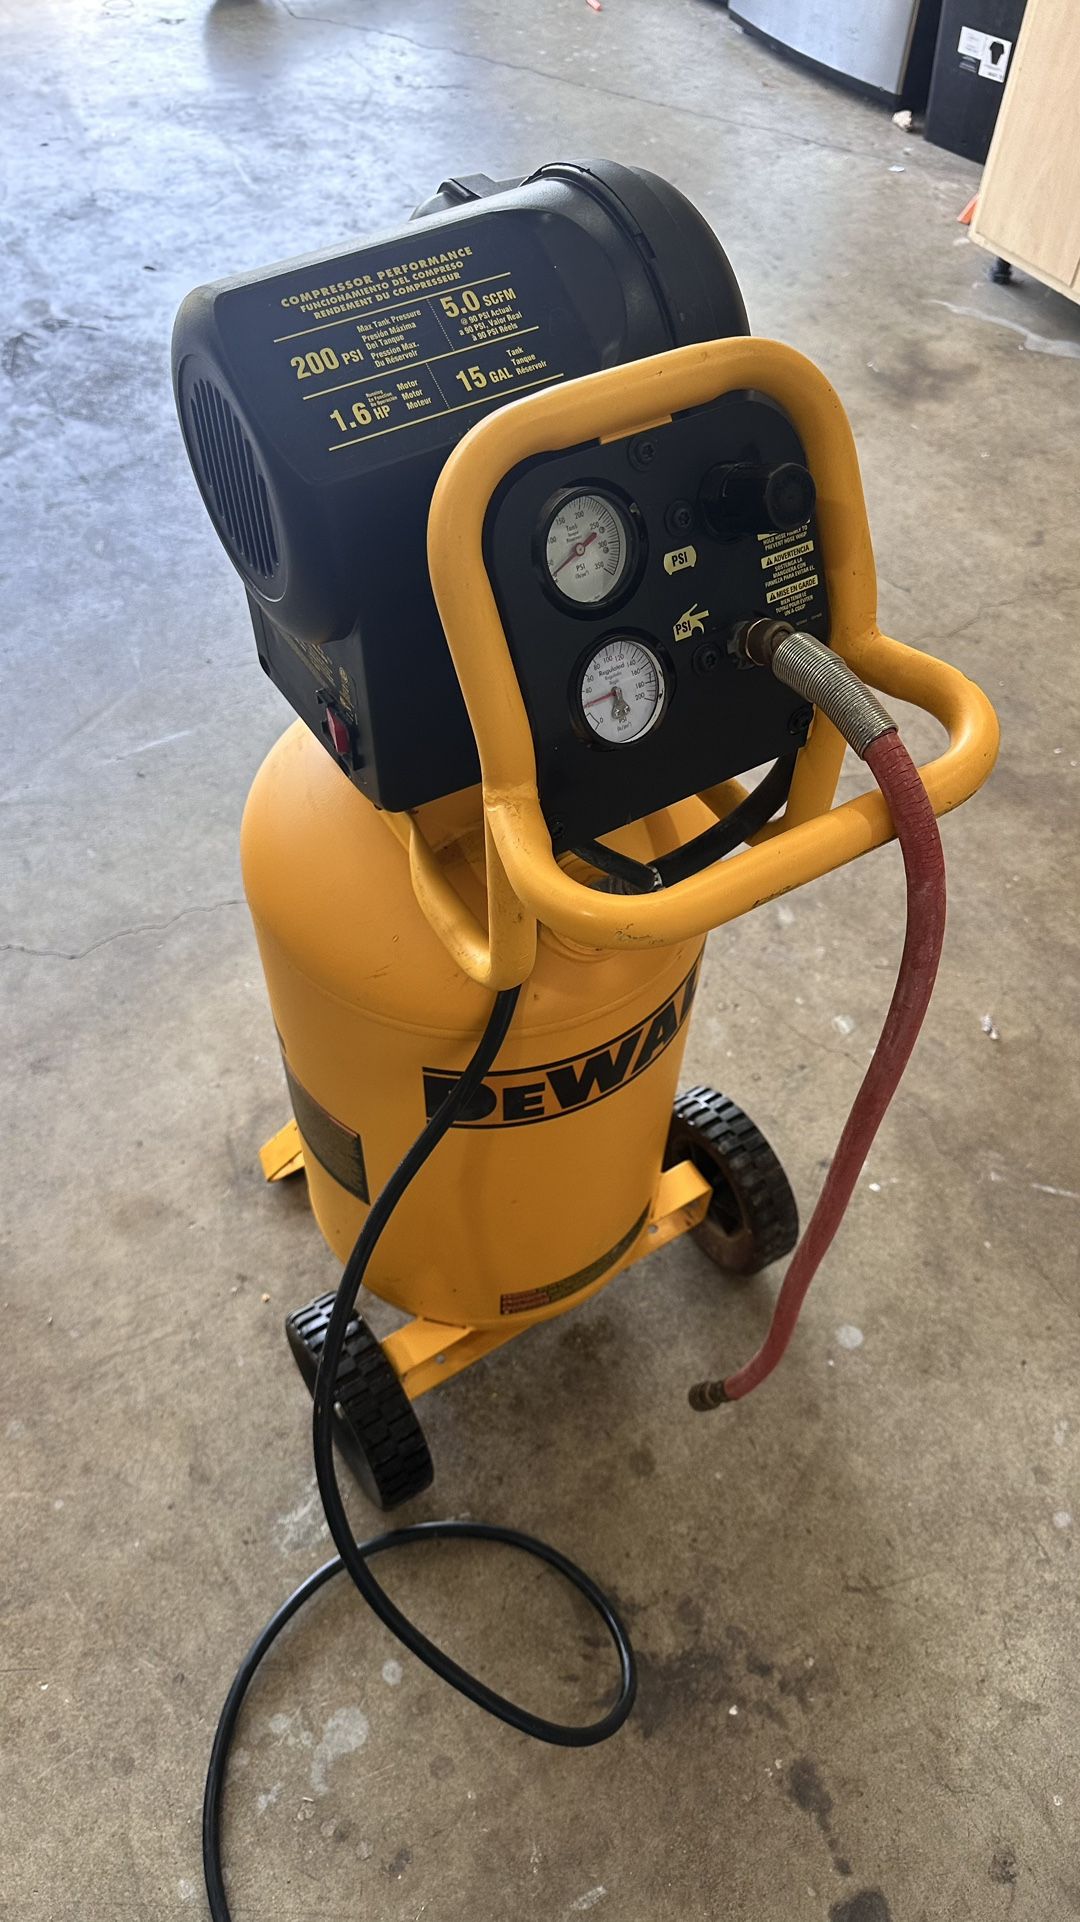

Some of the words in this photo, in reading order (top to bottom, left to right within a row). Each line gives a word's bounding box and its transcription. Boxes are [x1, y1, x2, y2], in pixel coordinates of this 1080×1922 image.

[280, 275, 373, 308] COMPRESSOR
[376, 246, 473, 281] PERFORMANCE
[300, 282, 390, 313] FUNCIONAMIENTO
[392, 275, 410, 287] DEL
[412, 260, 464, 281] COMPRESO
[314, 297, 373, 320] RENDEMENT
[375, 291, 390, 302] DU
[392, 271, 461, 296] COMPRESSEUR
[440, 290, 481, 318] 5.0
[482, 287, 517, 307] SCFM
[356, 324, 373, 334] Max
[373, 317, 391, 328] Tank
[390, 309, 422, 323] Pressure
[468, 315, 478, 324] 90
[478, 311, 490, 321] PSI
[490, 304, 513, 317] Actual
[464, 326, 474, 334] 90
[488, 316, 507, 328] Valor
[507, 311, 523, 322] Real
[361, 329, 389, 343] Presión
[388, 321, 417, 334] Máxima
[477, 331, 487, 341] 90
[487, 327, 500, 337] PSI
[365, 341, 379, 351] Del
[378, 333, 405, 347] Tanque
[370, 346, 401, 360] Pression
[401, 341, 420, 353] Max.
[505, 346, 524, 358] Tank
[290, 347, 340, 380] 200
[340, 348, 364, 365] PSI
[374, 359, 386, 368] Du
[510, 353, 537, 366] Tanque
[515, 360, 548, 376] Réservoir
[396, 379, 419, 391] Motor
[455, 365, 488, 392] 15
[488, 367, 514, 384] GAL
[401, 388, 423, 401] Motor
[406, 396, 432, 410] Moteur
[330, 402, 372, 432] 1.6
[372, 404, 391, 420] HP
[575, 511, 584, 520] 200
[590, 522, 600, 530] 250
[671, 551, 688, 567] PSI
[773, 544, 810, 563] ADVERTENCIA
[576, 564, 586, 572] PSI
[776, 588, 790, 598] MISE
[790, 585, 798, 593] EN
[798, 577, 816, 590] GARDE
[675, 619, 692, 636] PSI
[604, 656, 613, 664] 100
[615, 654, 625, 662] 120
[599, 663, 625, 676] Regulated
[632, 669, 641, 677] 160
[635, 693, 645, 701] 200
